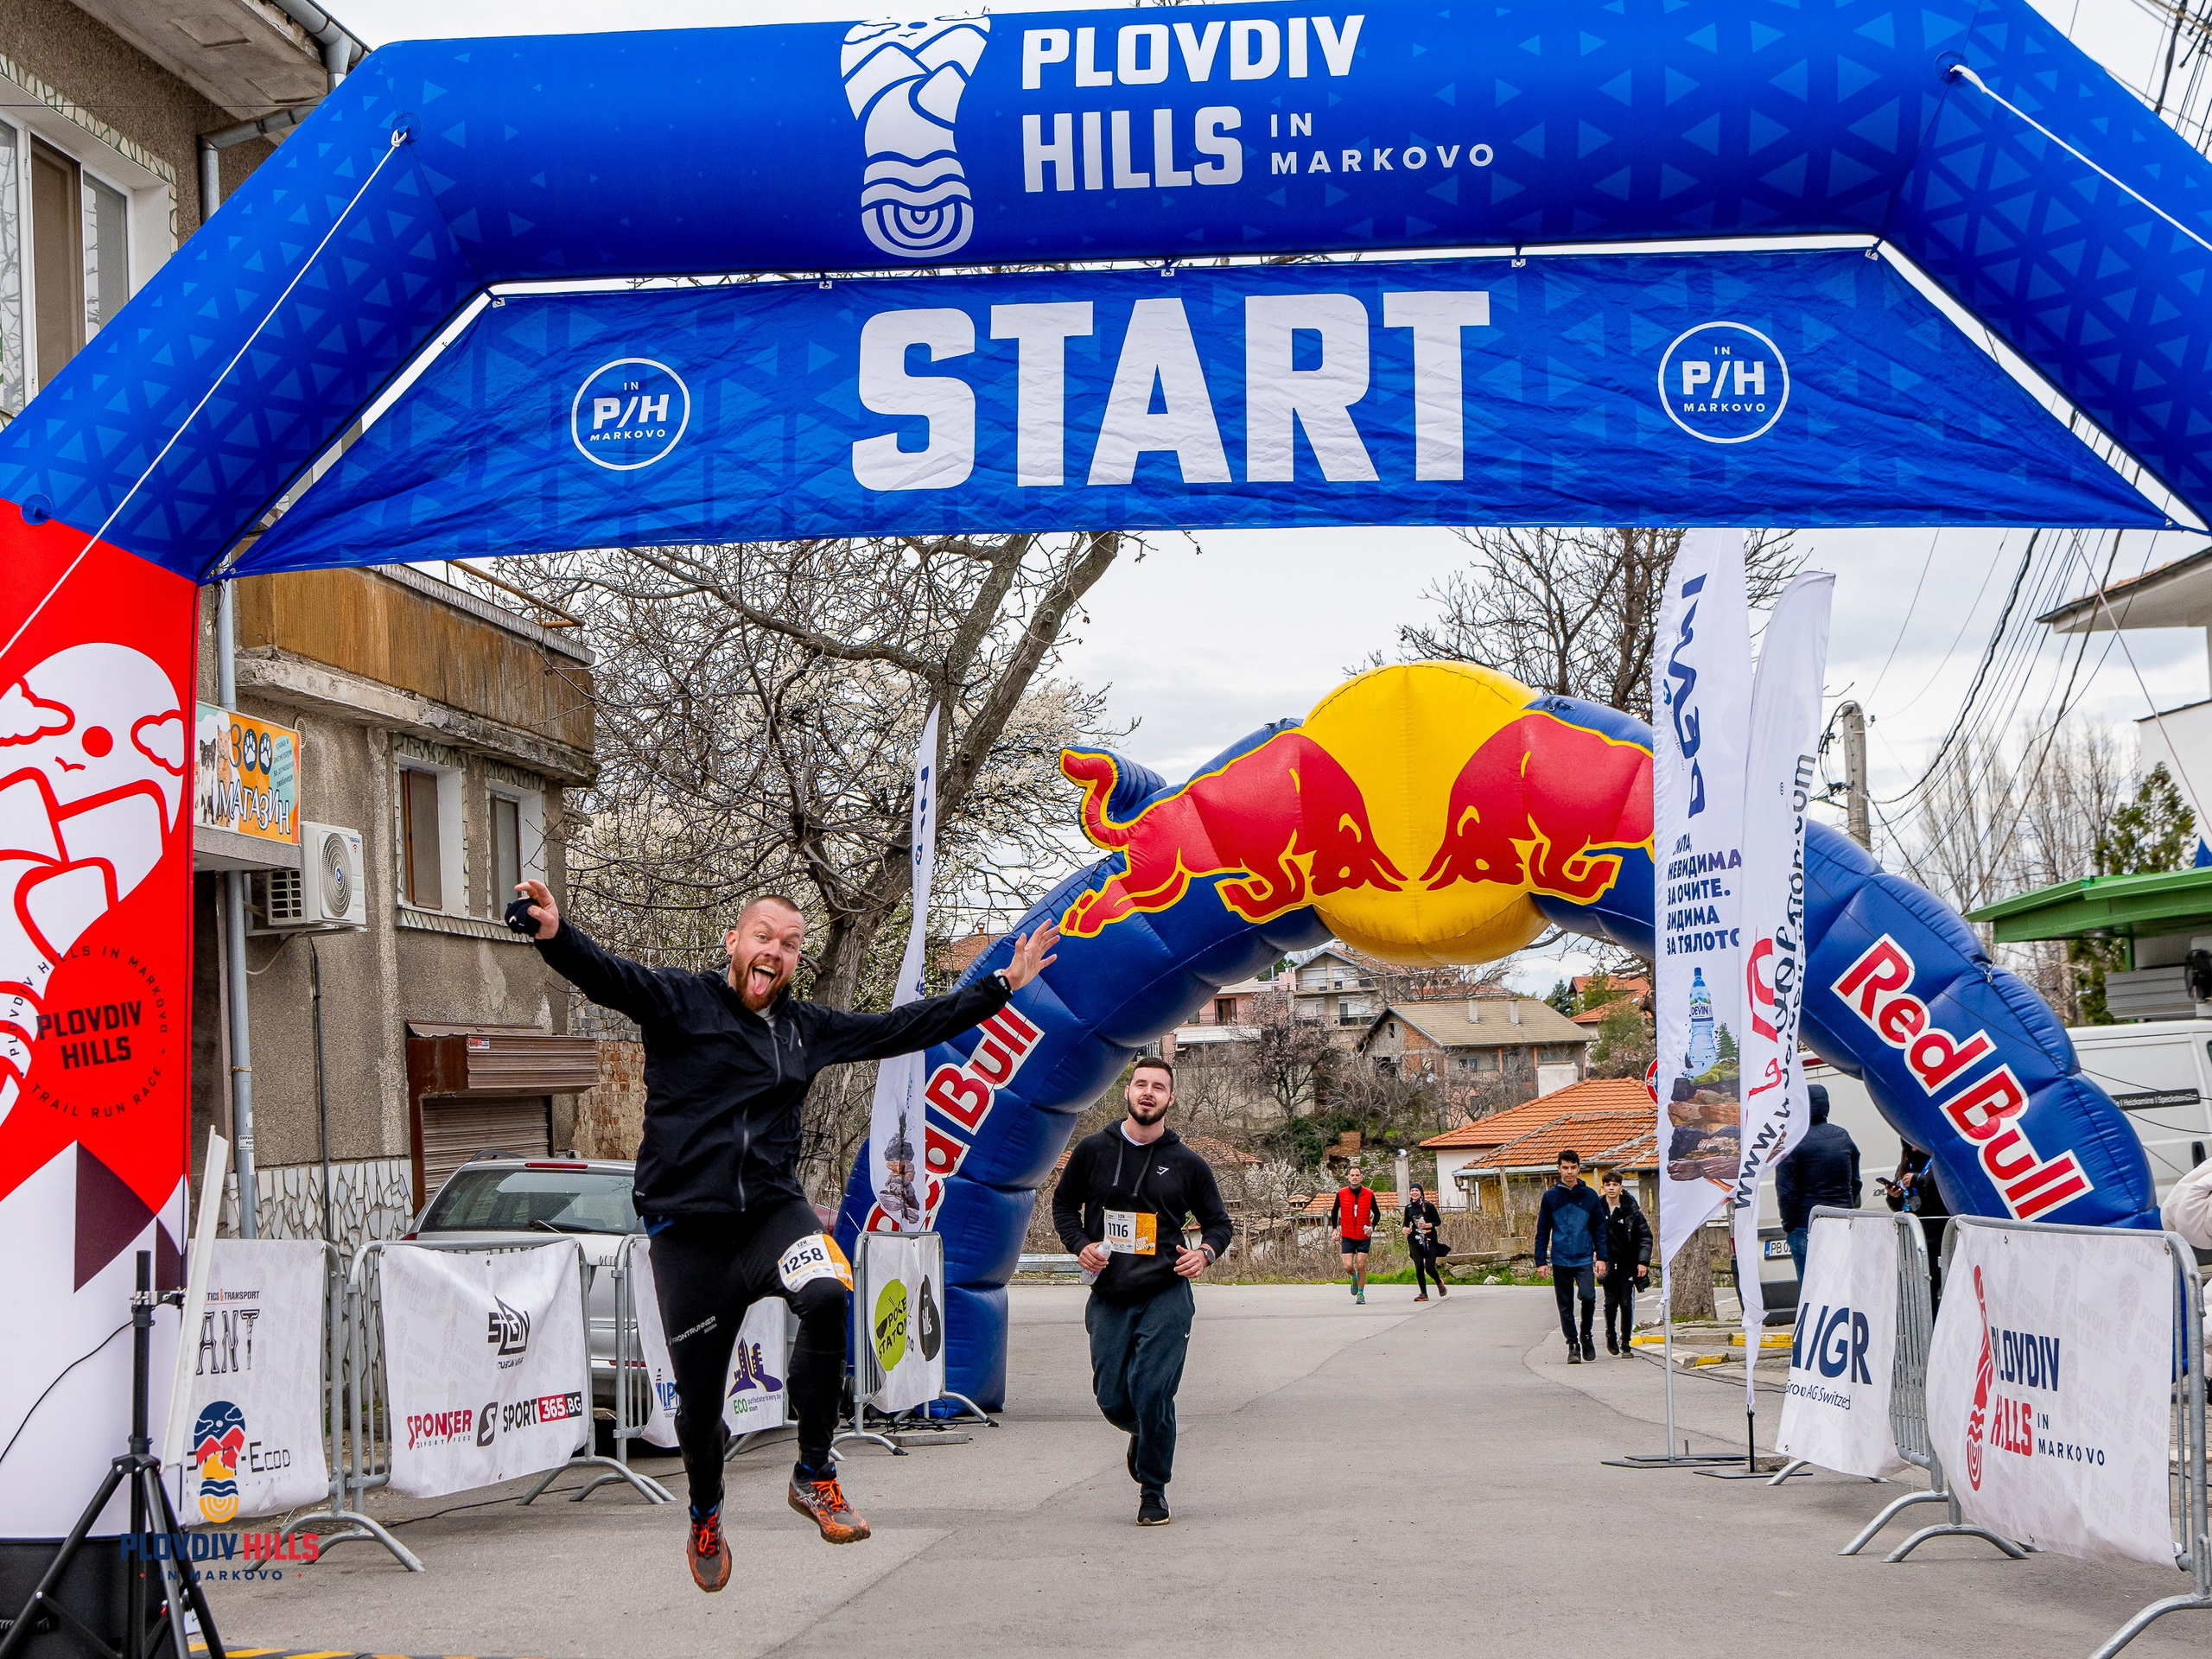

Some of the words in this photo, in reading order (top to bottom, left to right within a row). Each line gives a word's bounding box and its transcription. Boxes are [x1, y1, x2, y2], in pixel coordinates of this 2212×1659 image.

[1022, 14, 1365, 91] PLOVDIV
[1270, 112, 1312, 138] IN
[1022, 105, 1243, 194] HILLS
[1270, 143, 1494, 175] MARKOVO
[1713, 346, 1731, 356] IN
[623, 381, 639, 391] IN
[852, 290, 1491, 492] START
[1681, 360, 1765, 399] P/H
[593, 393, 670, 430] P/H
[1683, 403, 1766, 413] MARKOVO
[589, 429, 666, 442] MARKOVO
[218, 779, 291, 836] МАГАЗИН
[1668, 849, 1742, 881] НЕВИДИМА
[1668, 887, 1676, 906] ЗА
[1678, 877, 1732, 904] ОЧИТЕ.
[1667, 905, 1720, 932] ВИДИМА
[1667, 937, 1676, 956] ЗА
[38, 944, 91, 974] HILLS
[102, 945, 120, 959] IN
[128, 956, 168, 1033] MARKOVO
[35, 1000, 142, 1040] PLOVDIV
[1691, 1005, 1709, 1016] DEVIN
[60, 1035, 132, 1070] HILLS
[30, 1083, 79, 1117] TRAIL
[92, 1102, 126, 1119] RUN
[132, 1065, 162, 1103] RACE
[1834, 937, 1993, 1093] Red
[1942, 1066, 2090, 1222] Bull
[1108, 1222, 1128, 1238] 1116
[782, 1247, 824, 1275] 1258
[225, 1290, 260, 1301] TRANSPORT
[1990, 1325, 2060, 1392] PLOVDIV
[733, 1398, 748, 1415] ECO
[2037, 1412, 2050, 1430] IN
[406, 1409, 473, 1451] SPONSER
[1990, 1393, 2032, 1457] HILLS
[2037, 1438, 2106, 1466] MARKOVO
